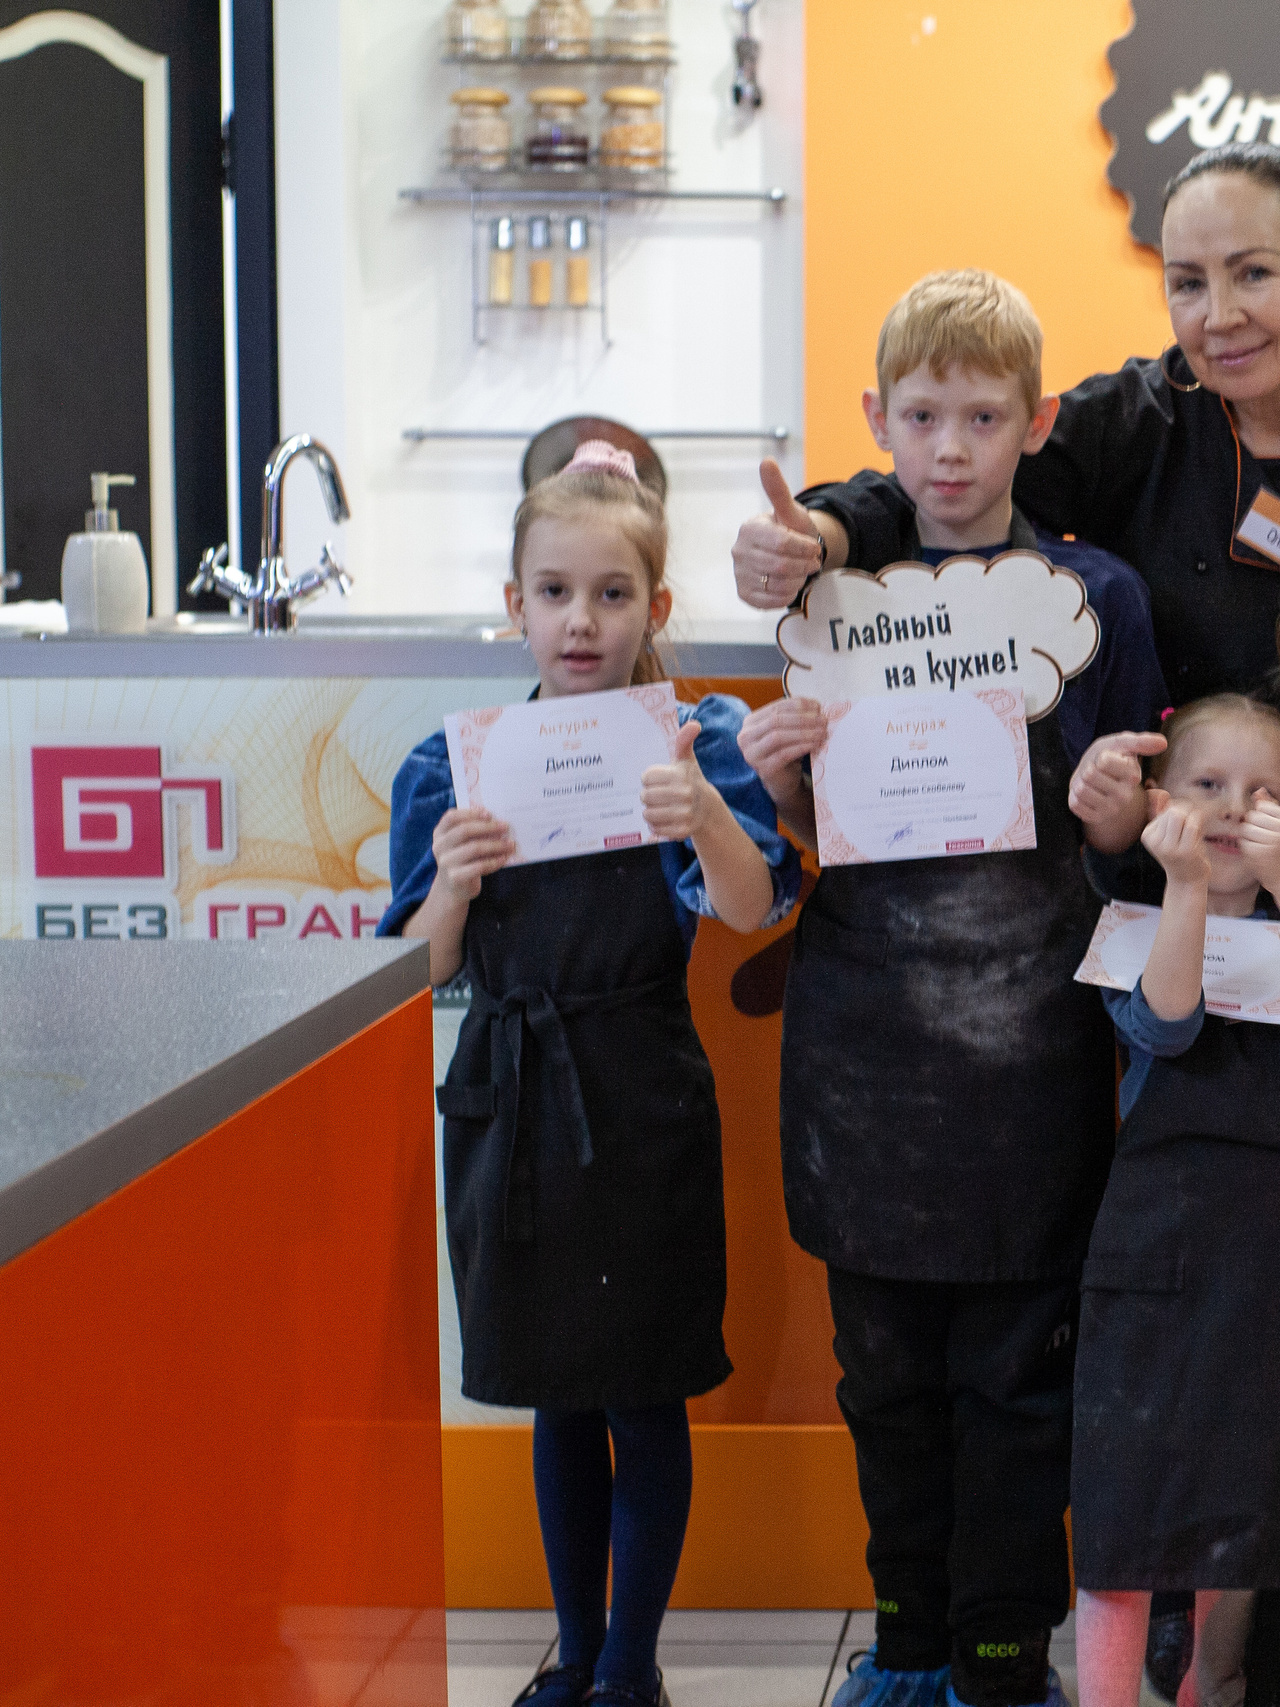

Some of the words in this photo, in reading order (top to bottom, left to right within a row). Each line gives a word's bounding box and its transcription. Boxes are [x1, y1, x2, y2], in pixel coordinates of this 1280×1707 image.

[829, 603, 952, 651] Главный
[885, 665, 916, 690] на
[926, 638, 1020, 692] кухне!
[539, 717, 599, 737] Антураж
[886, 717, 948, 739] Антураж
[545, 753, 603, 775] Диплом
[891, 756, 949, 774] Диплом
[36, 903, 168, 940] БЕЗ
